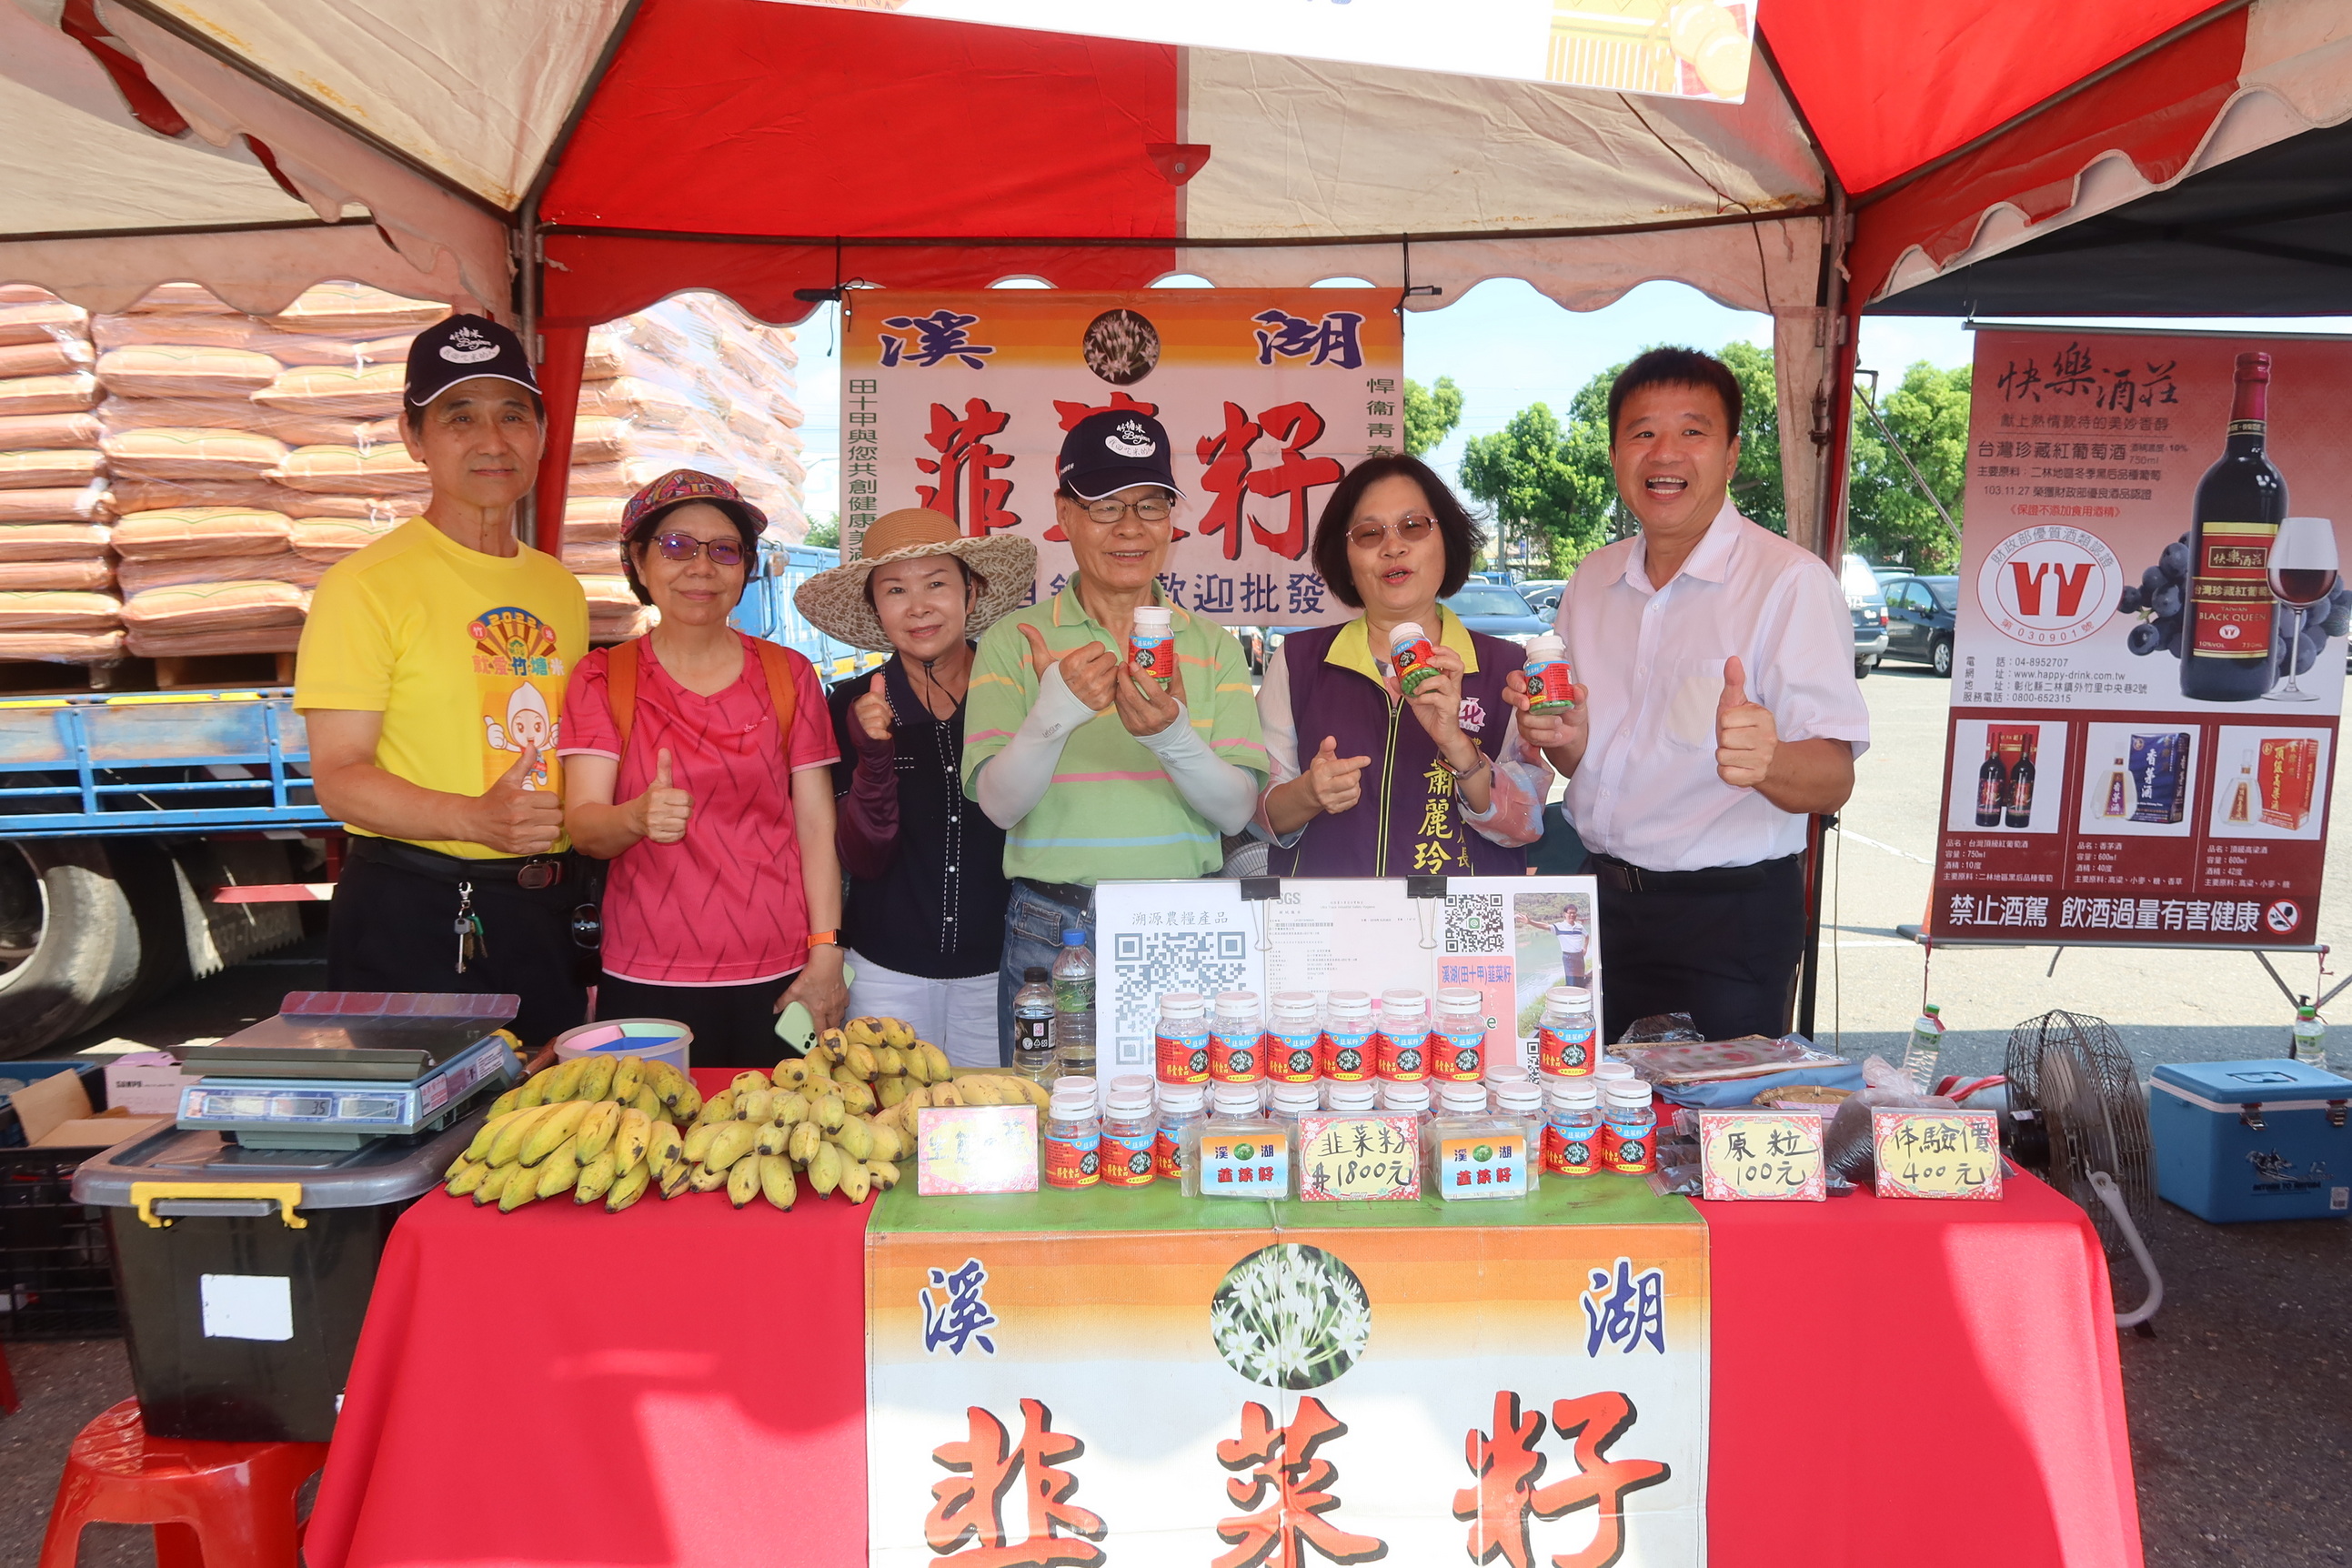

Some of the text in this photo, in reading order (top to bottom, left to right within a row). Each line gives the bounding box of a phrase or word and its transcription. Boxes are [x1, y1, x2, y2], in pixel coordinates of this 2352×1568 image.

[879, 311, 1364, 369] 溪 湖
[1997, 341, 2180, 413] 快樂酒莊
[1978, 440, 2126, 461] 台灣珍藏紅葡萄酒
[1990, 526, 2115, 569] 財政部優質酒類認證
[2194, 583, 2274, 598] 台灣珍藏紅葡萄
[487, 611, 538, 629] 2022
[2198, 612, 2267, 622] BLACK QUEEN
[472, 654, 565, 677] 就愛竹塘米
[1276, 892, 1301, 905] SGS
[1131, 910, 1229, 927] 溯源農糧產品
[1949, 893, 2261, 933] 禁止酒駕 飲酒過量有害健康
[312, 1101, 326, 1116] 35
[1215, 1144, 1274, 1159] 溪 湖
[1454, 1145, 1512, 1161] 溪 湖
[1724, 1129, 1819, 1162] 原粒
[1737, 1161, 1806, 1187] 100元
[920, 1260, 1666, 1355] 溪 湖
